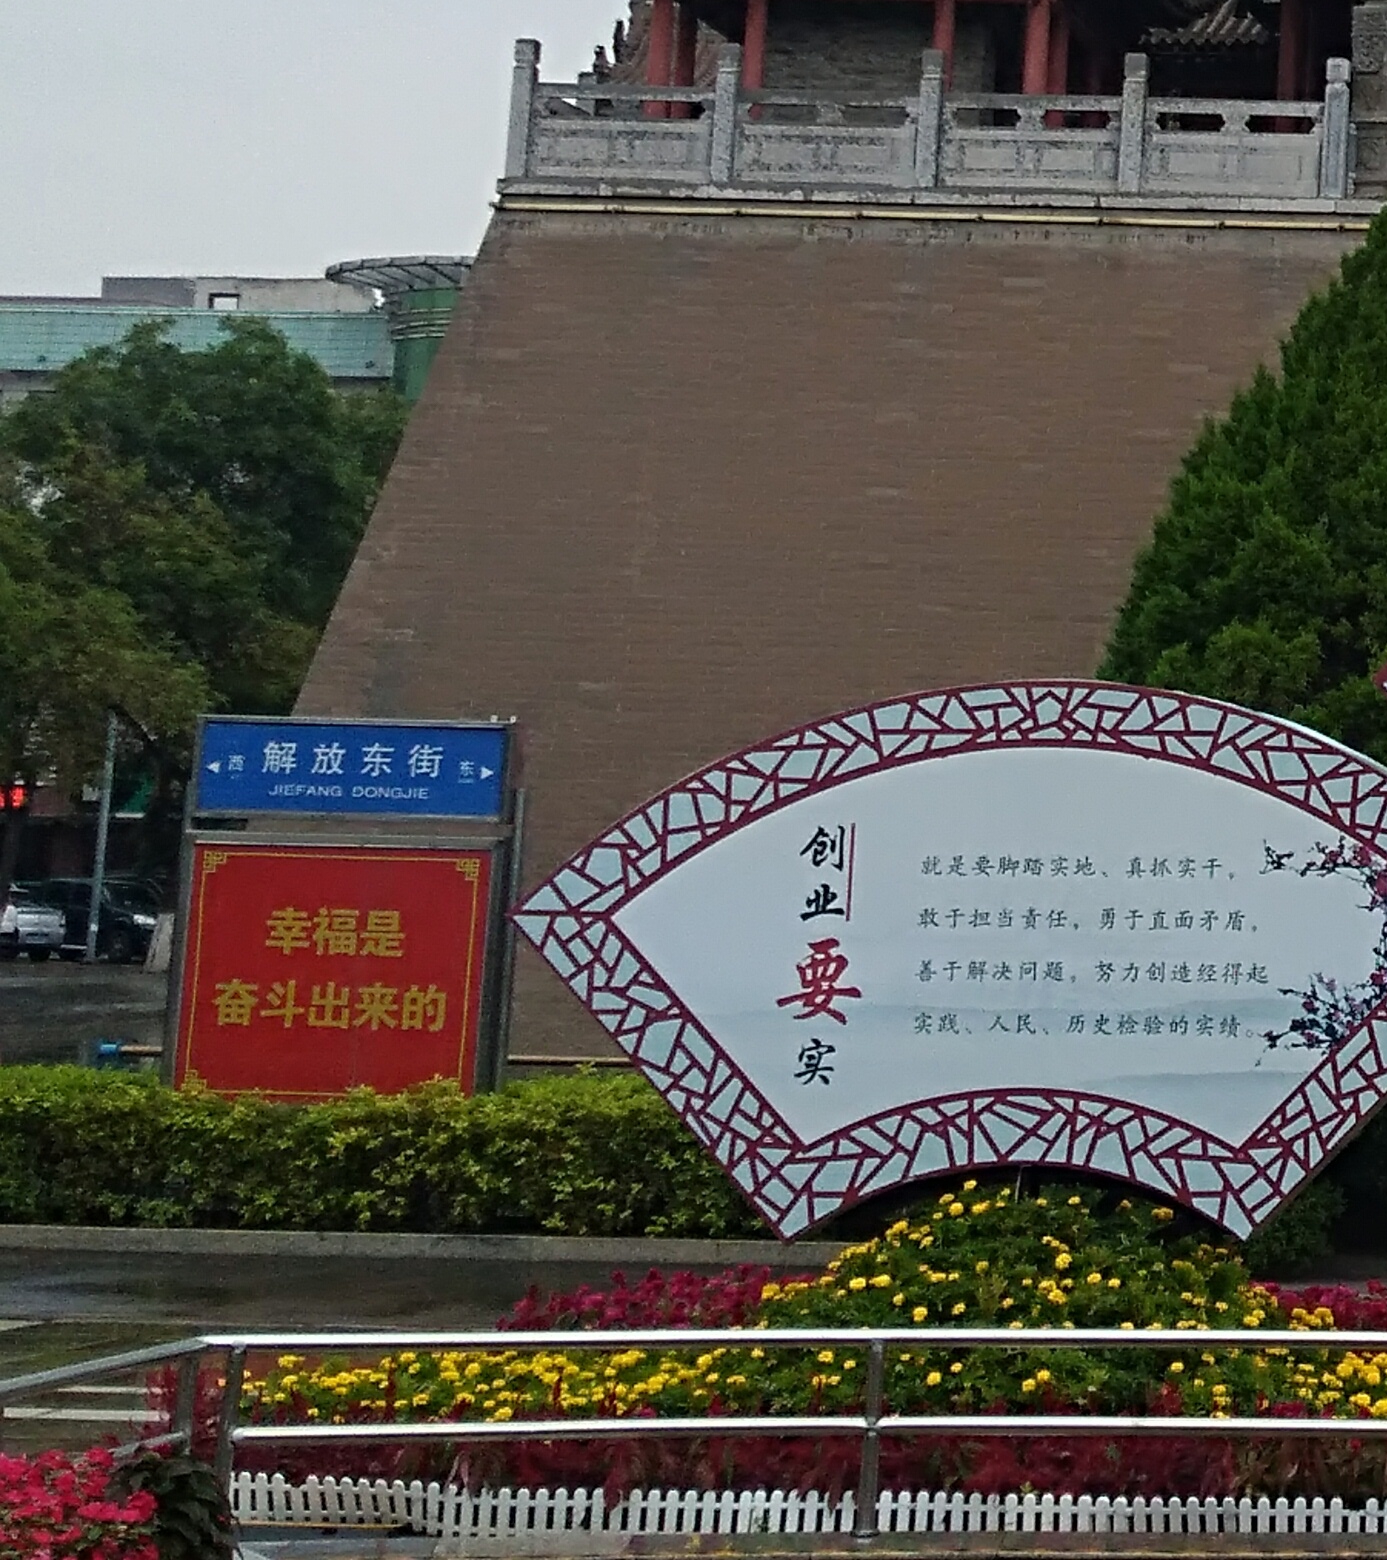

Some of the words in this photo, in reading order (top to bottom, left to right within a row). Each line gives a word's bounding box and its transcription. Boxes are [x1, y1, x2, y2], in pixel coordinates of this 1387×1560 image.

[261, 740, 444, 778] 解放东街
[459, 760, 475, 777] 东
[267, 784, 343, 798] JIEFANG
[352, 785, 430, 800] DONGJIE
[266, 907, 405, 957] 幸福是
[776, 824, 862, 1086] 创业要实
[914, 959, 1270, 986] 善于解决问题，努力创造经得起
[213, 979, 447, 1032] 奋斗出来的
